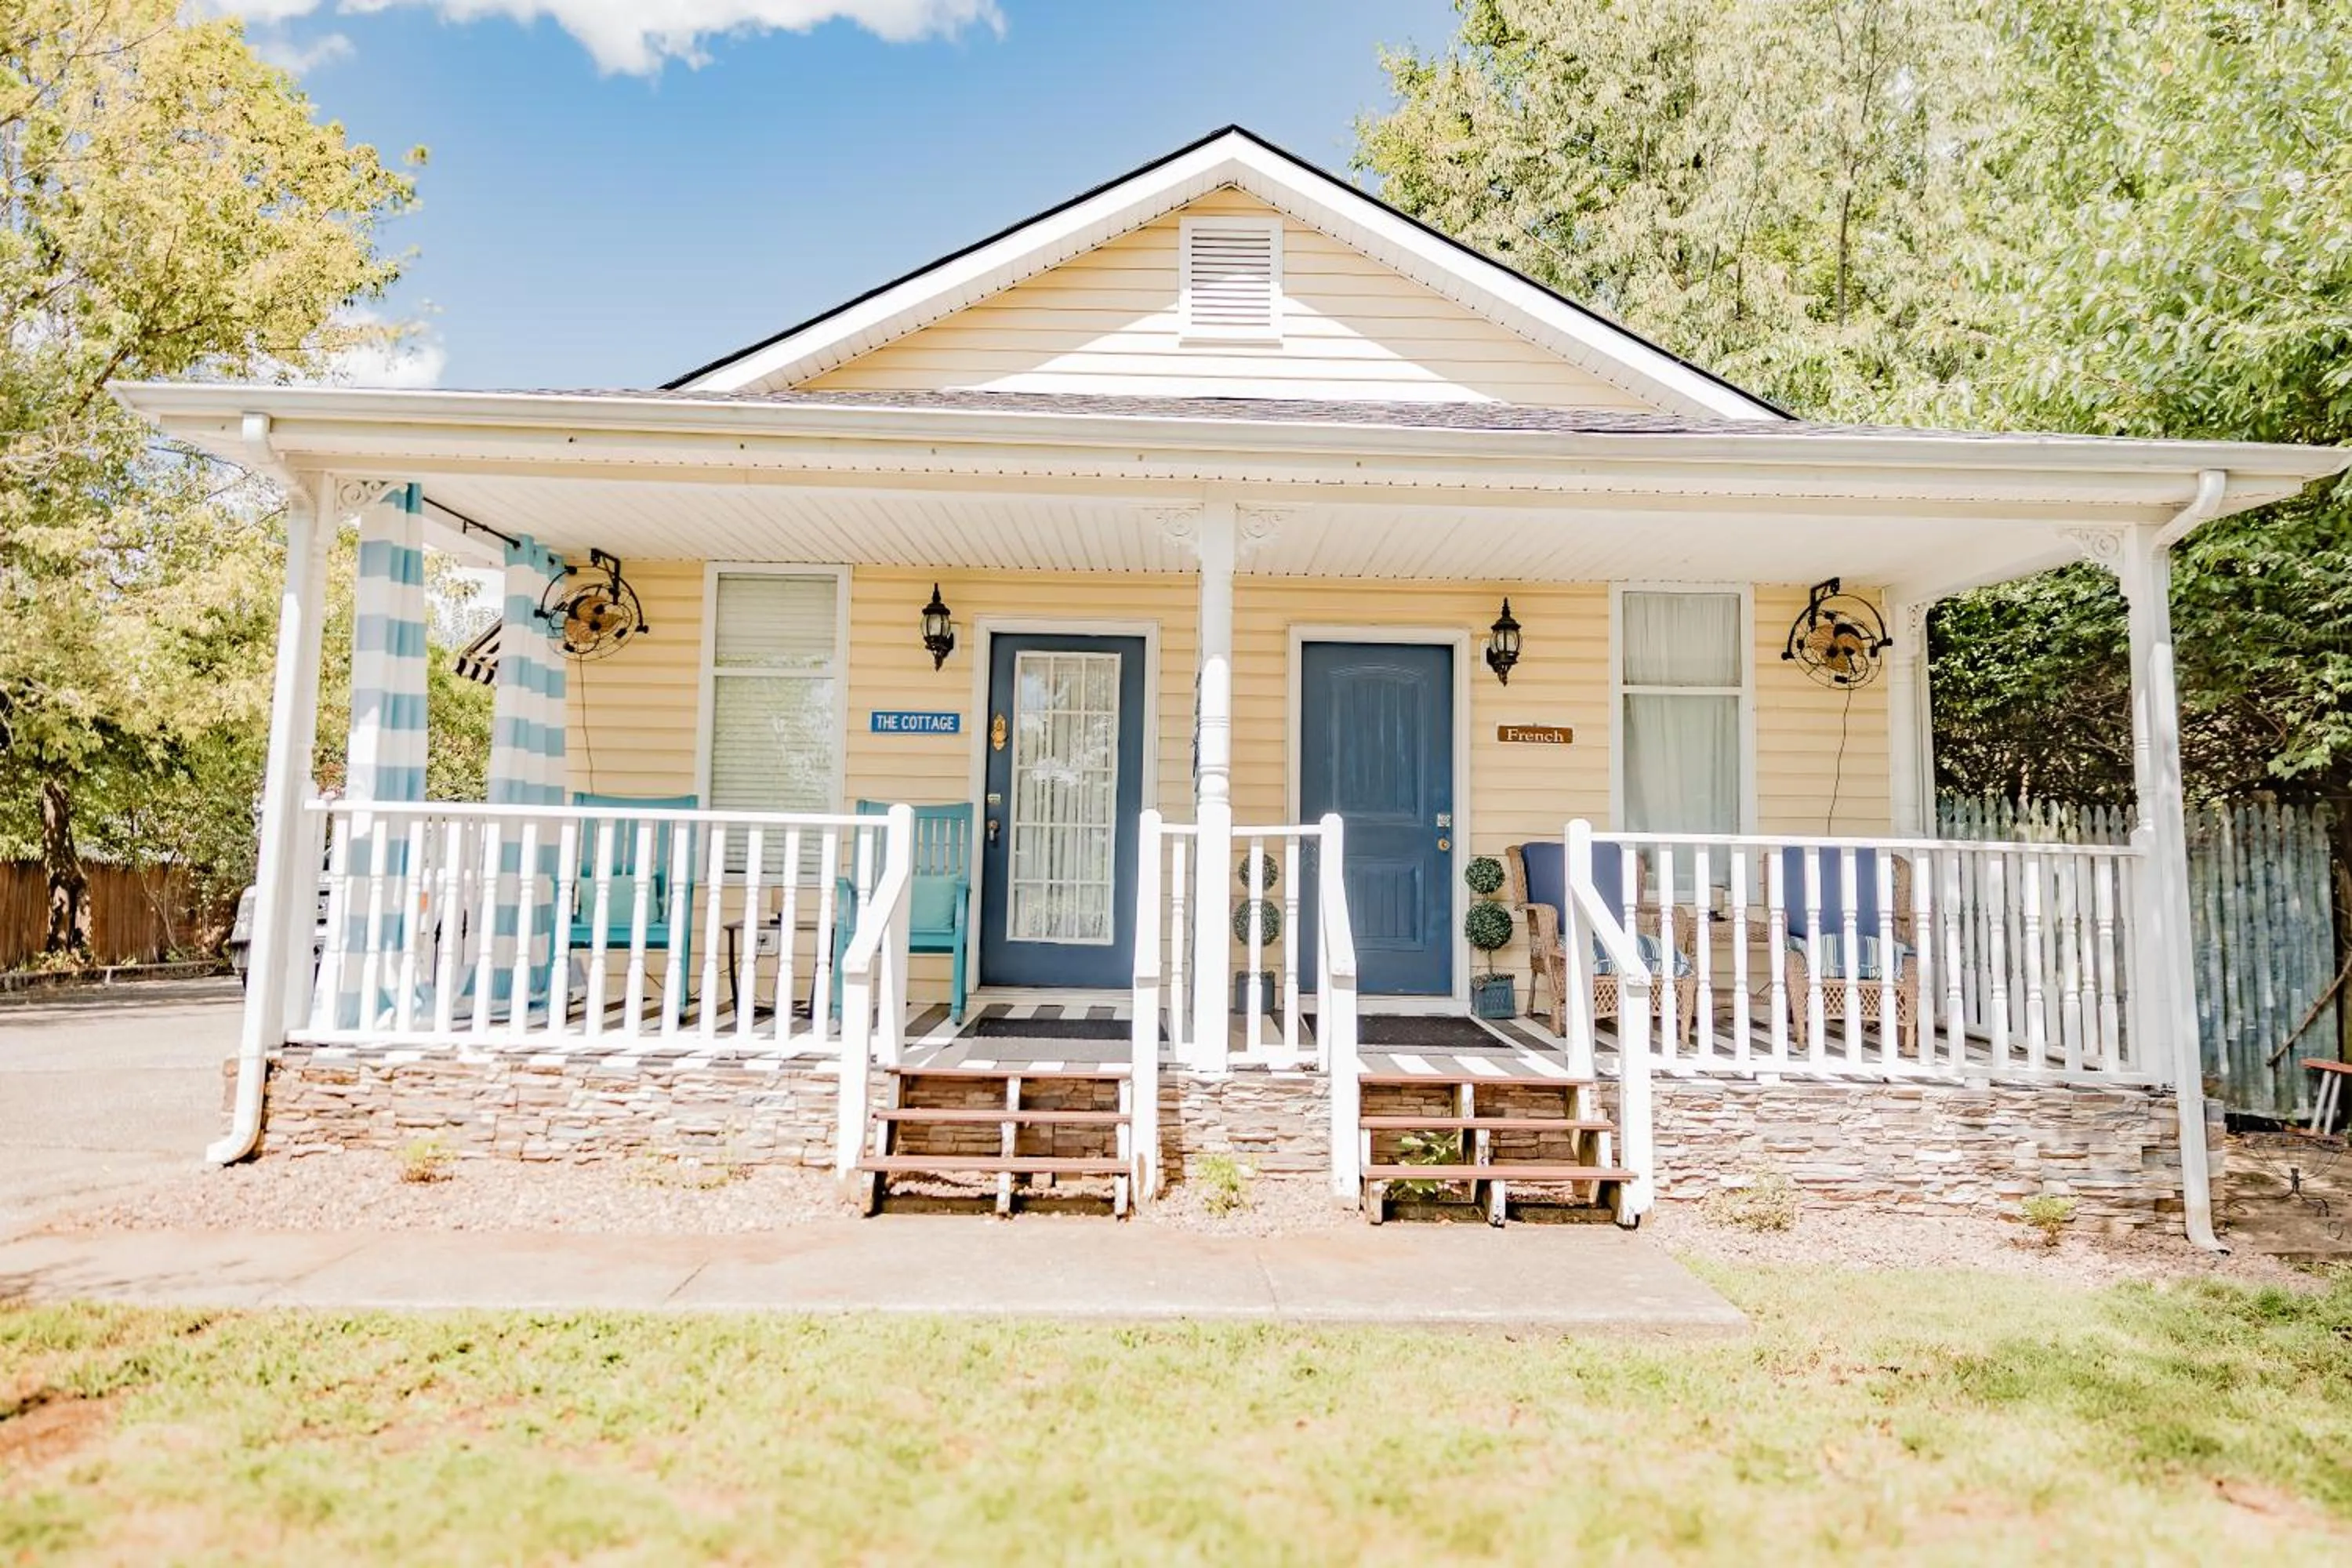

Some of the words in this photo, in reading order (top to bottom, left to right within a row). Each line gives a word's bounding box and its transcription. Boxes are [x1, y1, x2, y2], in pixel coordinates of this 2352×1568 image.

[877, 714, 898, 729] THE
[901, 714, 954, 730] COTTAGE
[1507, 728, 1563, 742] French
